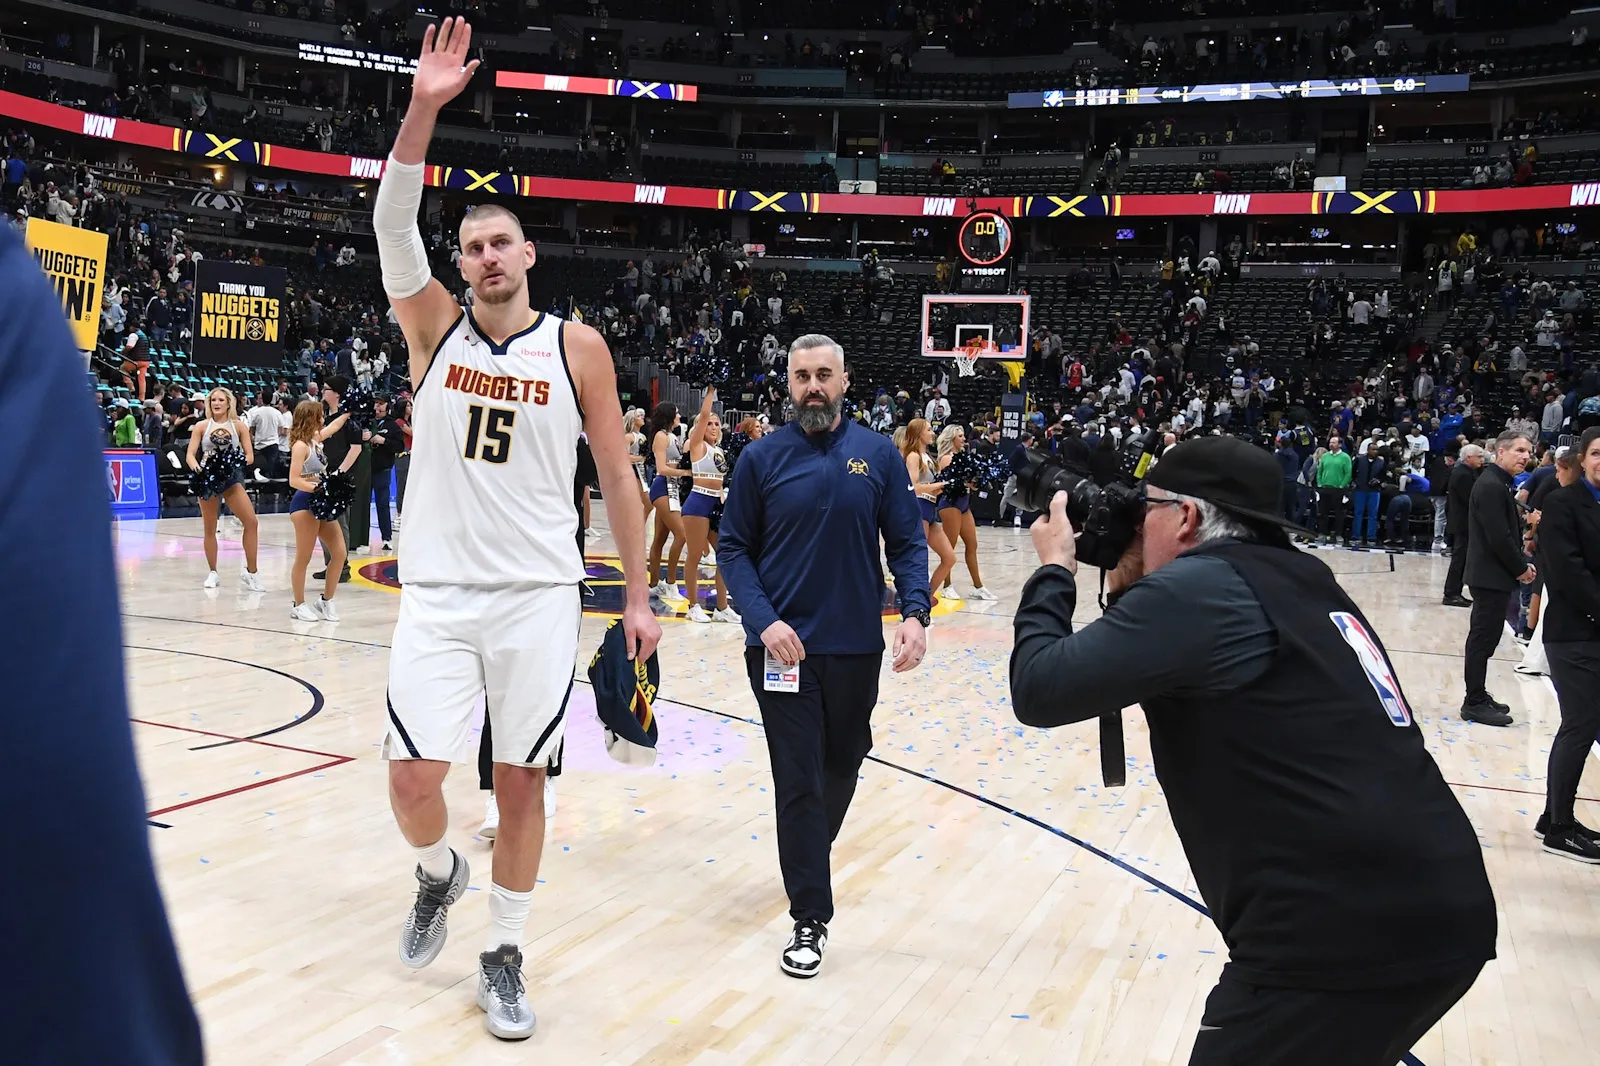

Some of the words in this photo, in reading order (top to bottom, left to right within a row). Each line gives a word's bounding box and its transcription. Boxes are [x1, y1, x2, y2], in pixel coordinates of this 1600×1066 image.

[298, 52, 325, 62] PLEASE
[363, 61, 372, 69] TO
[374, 62, 396, 72] DRIVE
[355, 51, 365, 59] TO
[367, 52, 381, 62] THE
[27, 61, 41, 71] 206
[83, 113, 117, 139] WIN
[1469, 146, 1485, 154] 218
[350, 157, 382, 179] WIN
[103, 180, 142, 195] PLAYOFFS
[634, 184, 667, 204] WIN
[1570, 184, 1600, 206] WI
[922, 197, 956, 216] WIN
[1213, 194, 1251, 214] WIN
[283, 207, 311, 219] DENVER
[975, 221, 995, 235] 0.0
[973, 268, 1006, 276] TISSOT
[218, 282, 247, 295] THANK
[249, 284, 266, 297] YOU
[202, 292, 280, 319] NUGGETS
[521, 347, 552, 358] ibotta
[444, 363, 550, 406] NUGGETS
[464, 403, 517, 464] 15
[124, 475, 141, 485] prime
